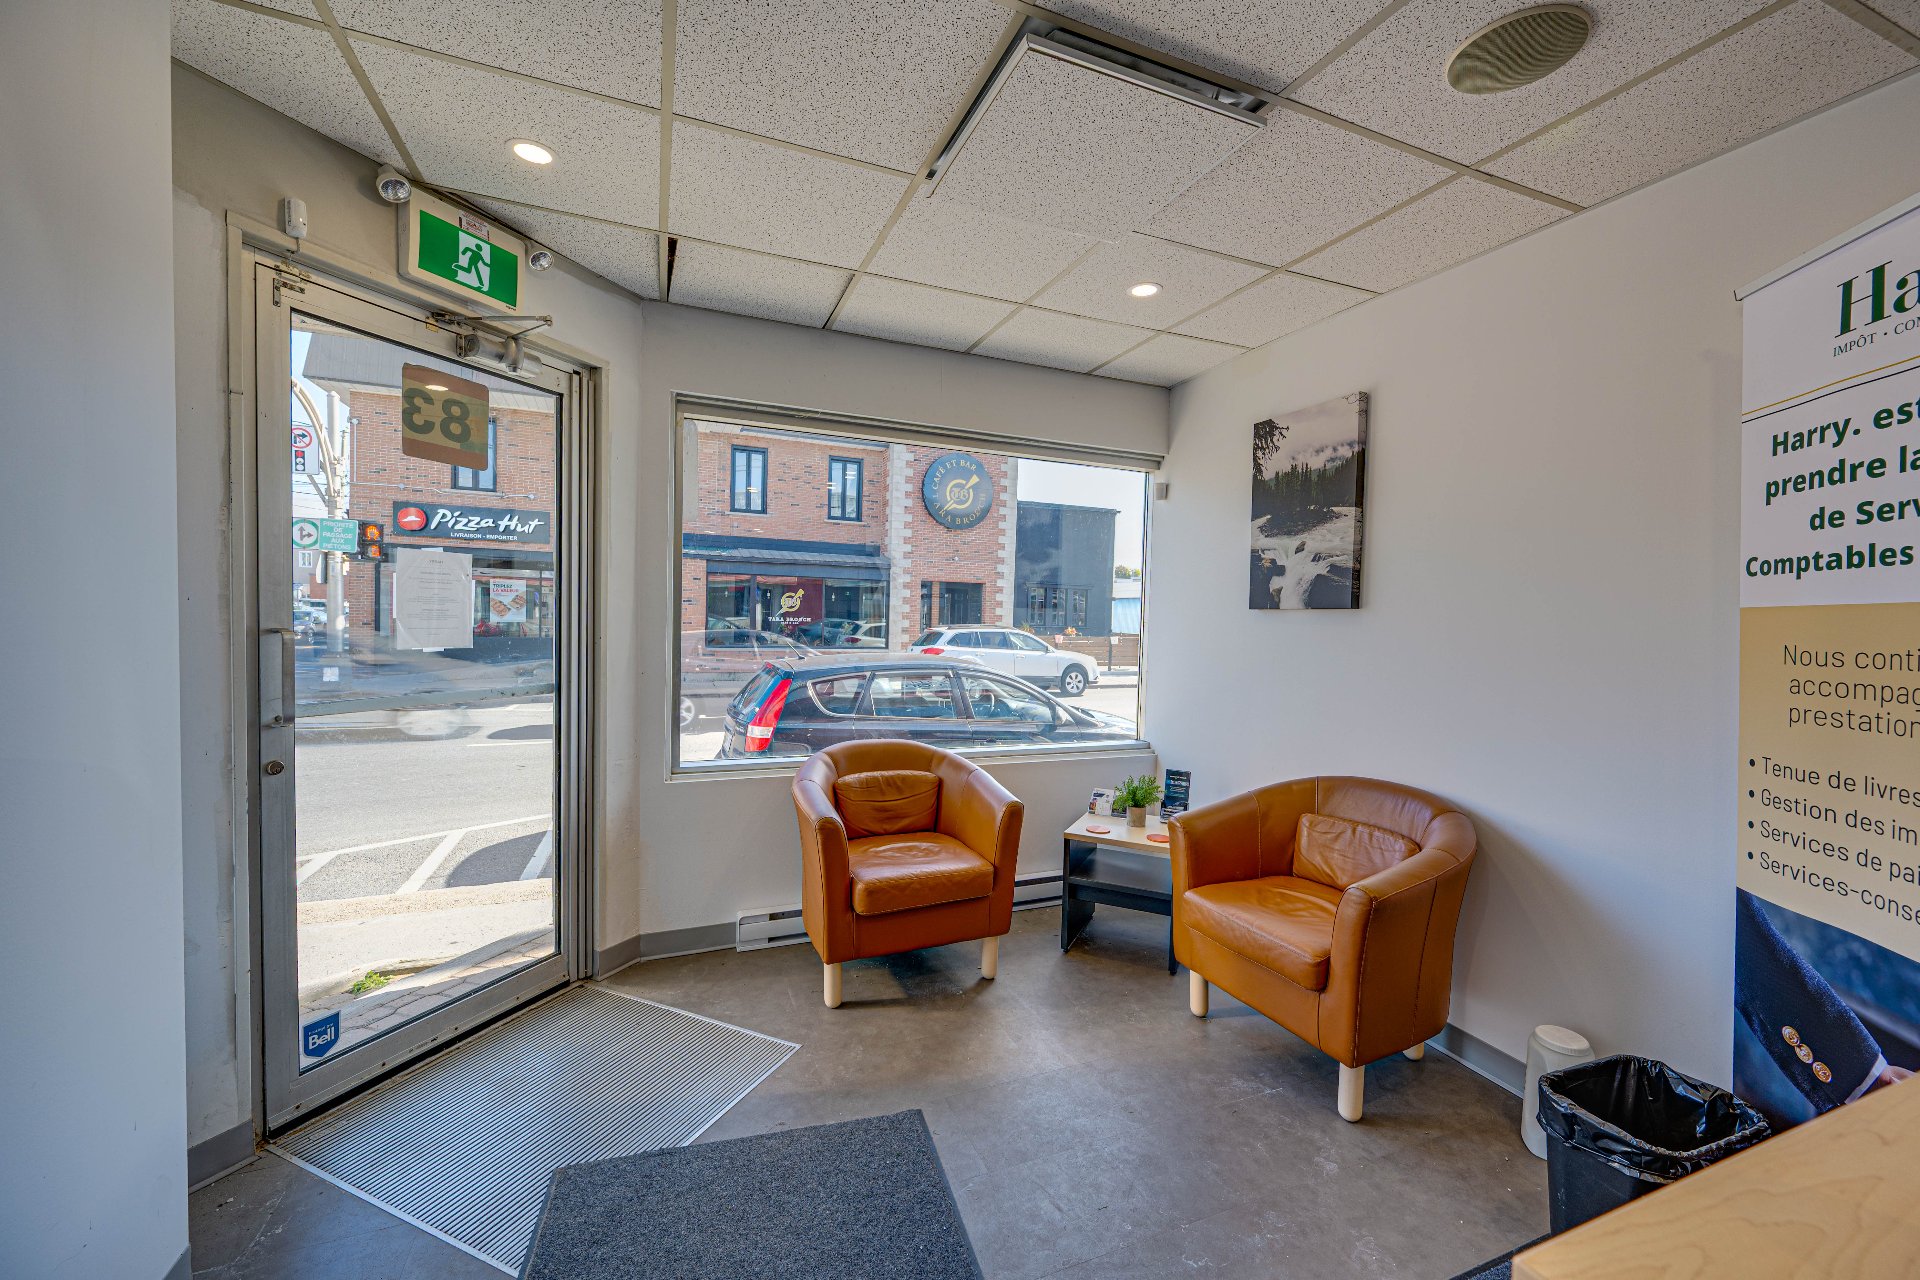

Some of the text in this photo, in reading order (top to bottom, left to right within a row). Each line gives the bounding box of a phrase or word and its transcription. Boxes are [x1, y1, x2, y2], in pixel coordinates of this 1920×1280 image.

[1834, 260, 1920, 339] Ha
[1832, 316, 1920, 357] IMPÔT CO
[1772, 417, 1861, 457] Harry.
[931, 459, 977, 490] CAFÉ ET BAR
[1765, 458, 1887, 506] prendre
[430, 508, 545, 534] Pizza Hut
[1809, 506, 1845, 531] de
[1745, 543, 1914, 580] Comptables
[1783, 644, 1845, 668] Nous
[1761, 756, 1820, 785] Tenue
[1828, 770, 1856, 792] de
[1760, 788, 1918, 846] Gestion des im
[1760, 820, 1849, 862] Services
[1856, 848, 1882, 872] de
[308, 1026, 335, 1050] Bell
